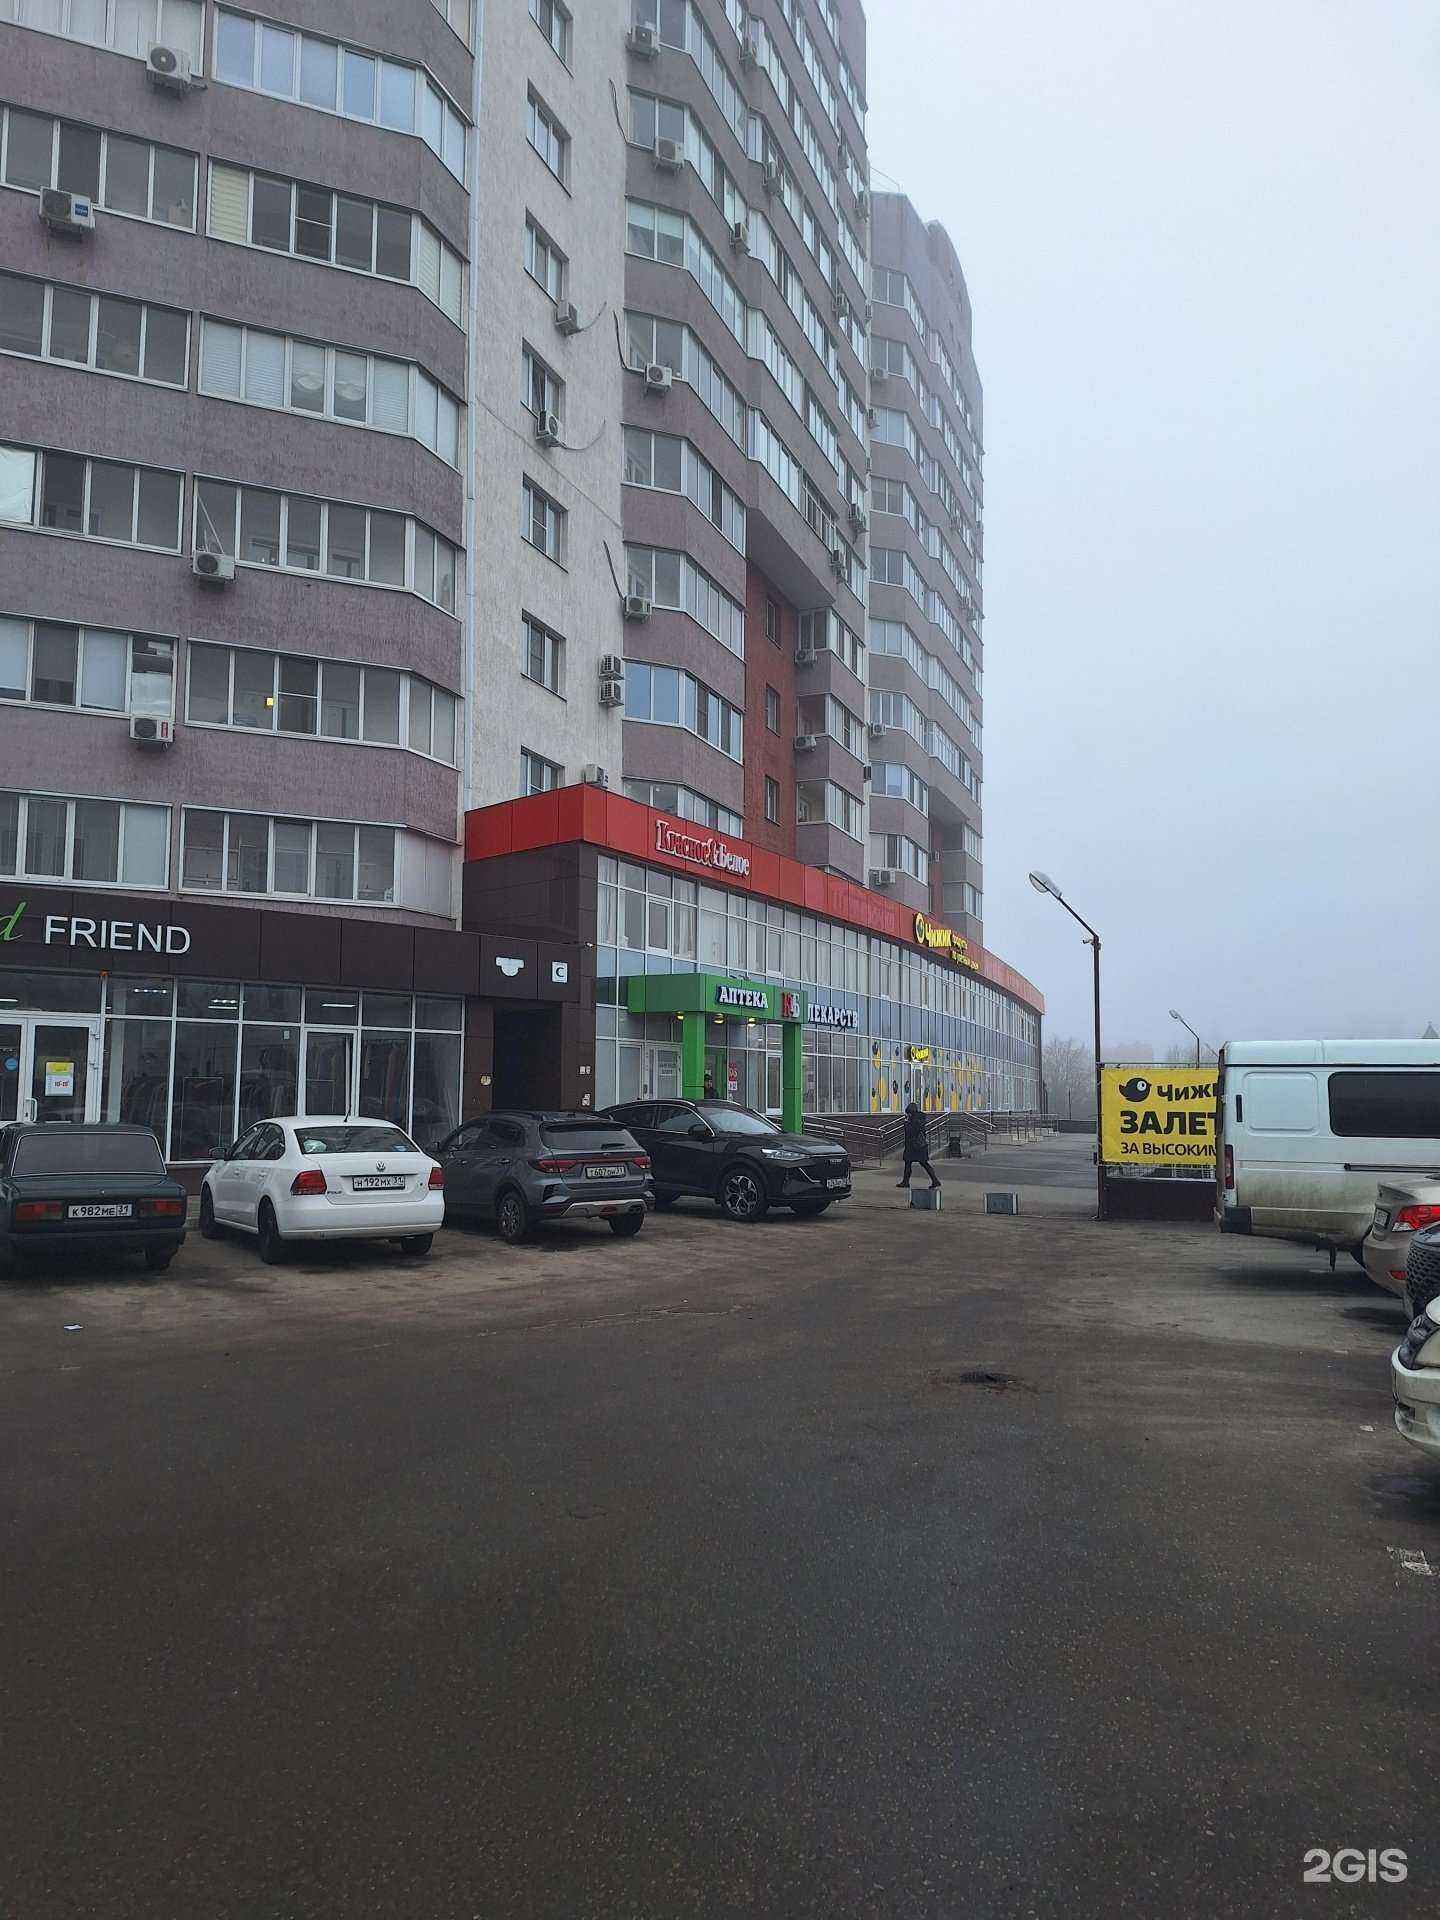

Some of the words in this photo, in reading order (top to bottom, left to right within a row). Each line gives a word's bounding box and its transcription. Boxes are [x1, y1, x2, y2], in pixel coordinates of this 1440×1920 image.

[45, 915, 191, 954] FRIEND
[719, 986, 769, 1009] АПТЕКА
[807, 1003, 858, 1029] ЛЕКАРСТВ
[1120, 1142, 1139, 1154] ЗА
